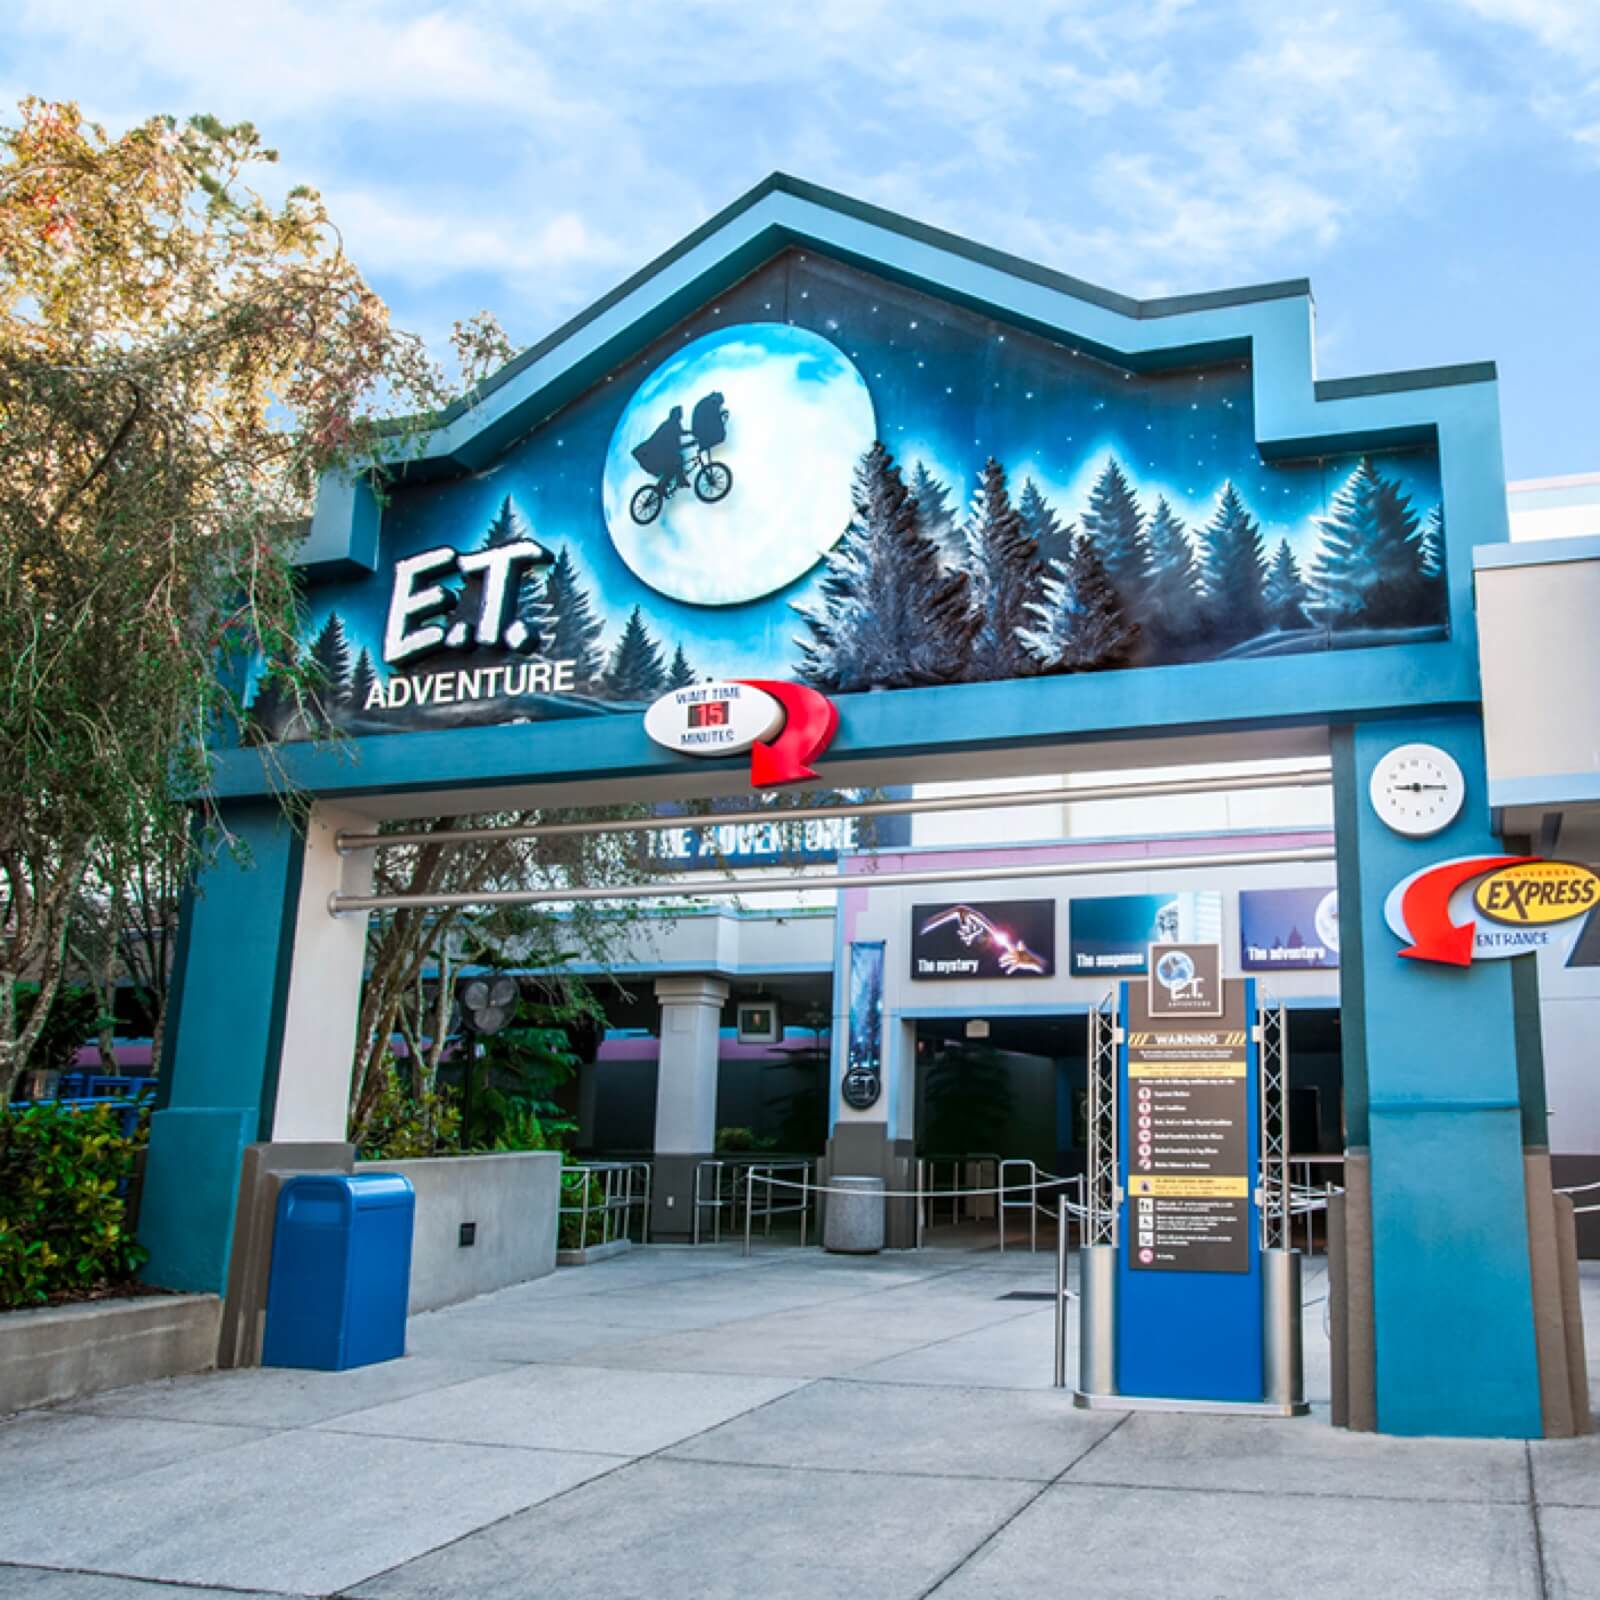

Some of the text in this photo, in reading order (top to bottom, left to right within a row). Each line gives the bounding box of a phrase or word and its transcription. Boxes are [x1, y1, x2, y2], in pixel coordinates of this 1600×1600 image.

[383, 541, 543, 661] E.T.
[364, 660, 577, 710] ADVENTURE
[676, 687, 740, 704] WAIT TIME
[697, 702, 724, 725] 15
[681, 730, 734, 744] MINUTES
[1487, 878, 1595, 920] EXPRESS
[1477, 932, 1548, 946] ENTRANCE
[1077, 953, 1094, 968] The
[1248, 946, 1267, 960] The
[918, 959, 979, 974] The mystery
[1155, 1033, 1217, 1045] WARNING
